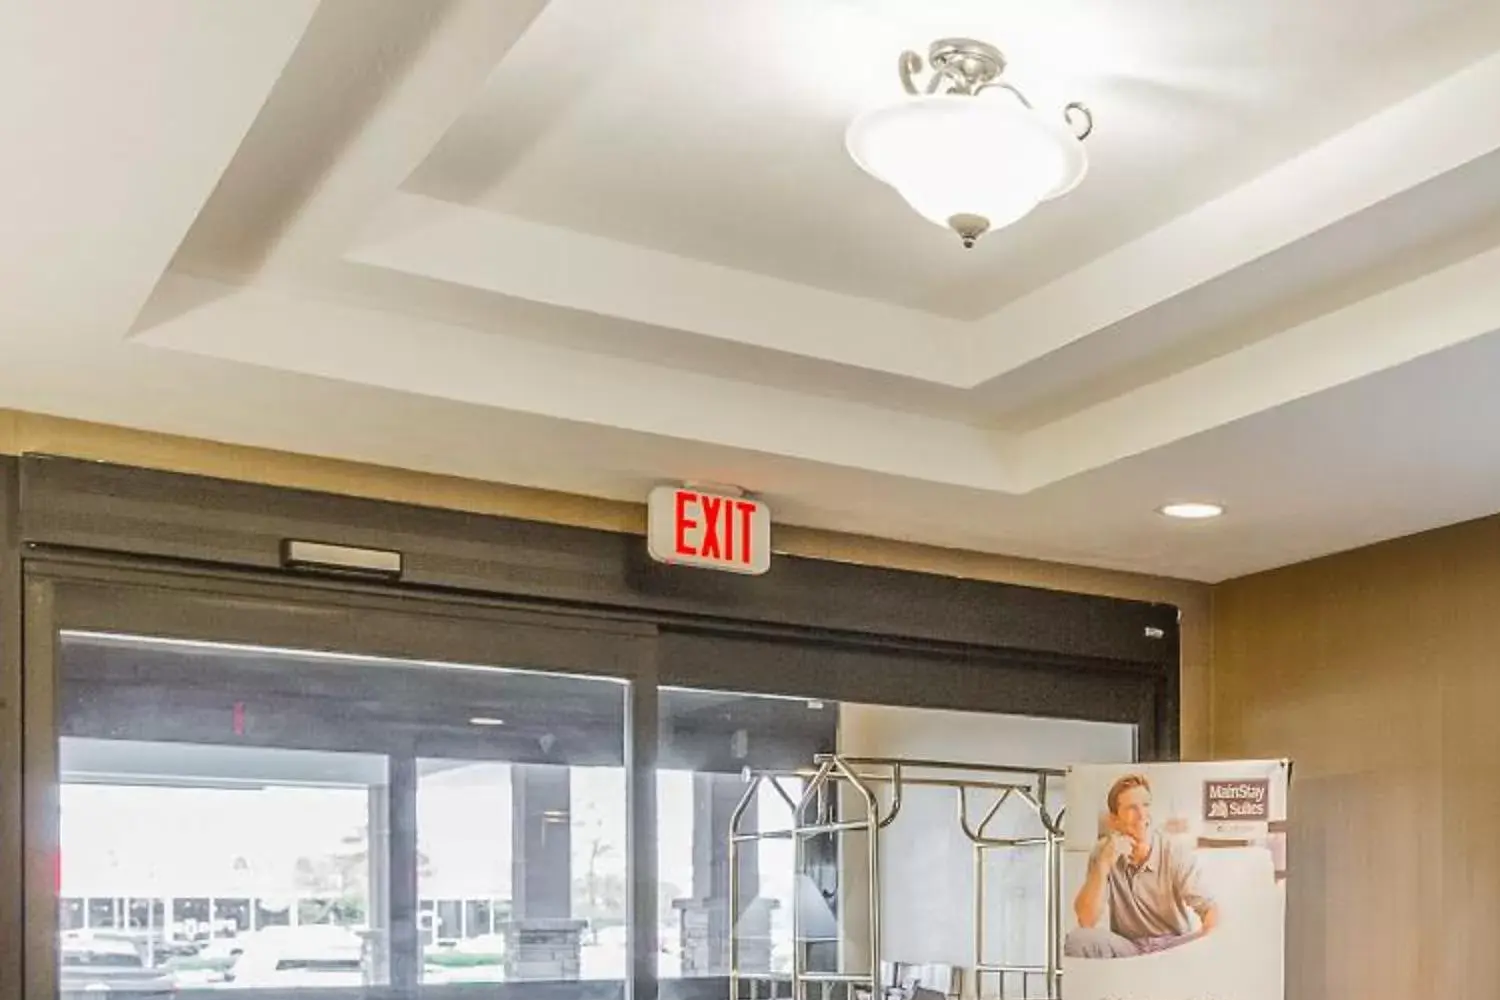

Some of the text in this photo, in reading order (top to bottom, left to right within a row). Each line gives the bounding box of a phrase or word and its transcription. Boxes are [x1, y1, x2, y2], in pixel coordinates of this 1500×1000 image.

[675, 490, 757, 565] EXIT
[1209, 783, 1265, 802] MainStay
[1229, 801, 1264, 815] Suites
